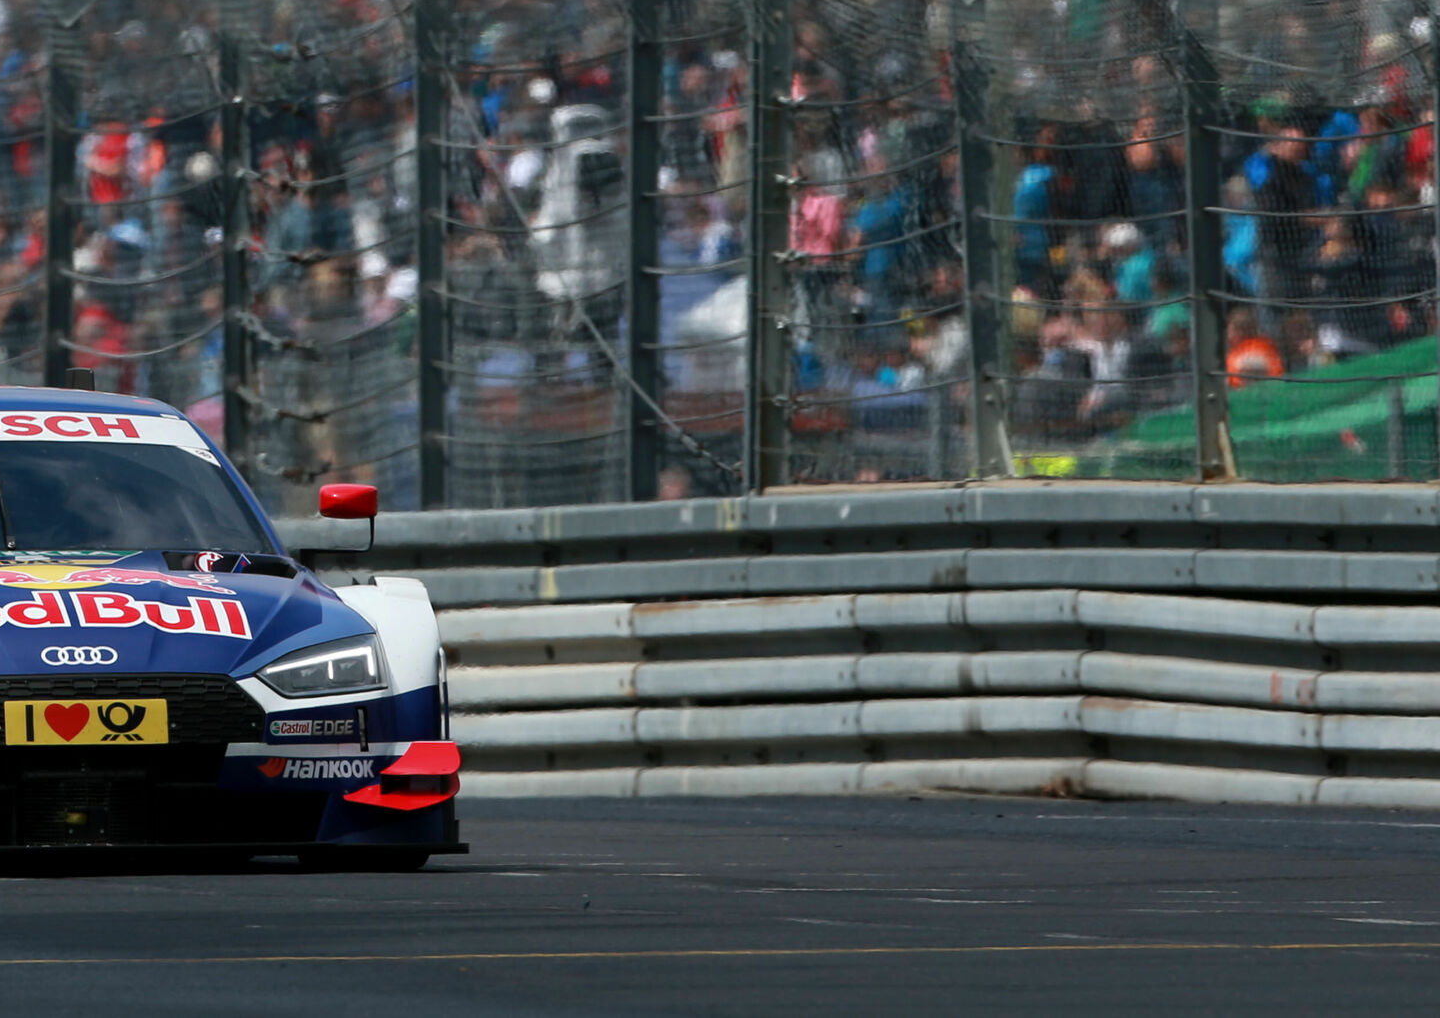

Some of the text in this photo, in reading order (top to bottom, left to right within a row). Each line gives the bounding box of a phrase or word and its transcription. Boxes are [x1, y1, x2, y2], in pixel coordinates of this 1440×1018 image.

[70, 591, 252, 639] Bull
[25, 704, 35, 742] I
[280, 719, 354, 736] Castrol EDGE
